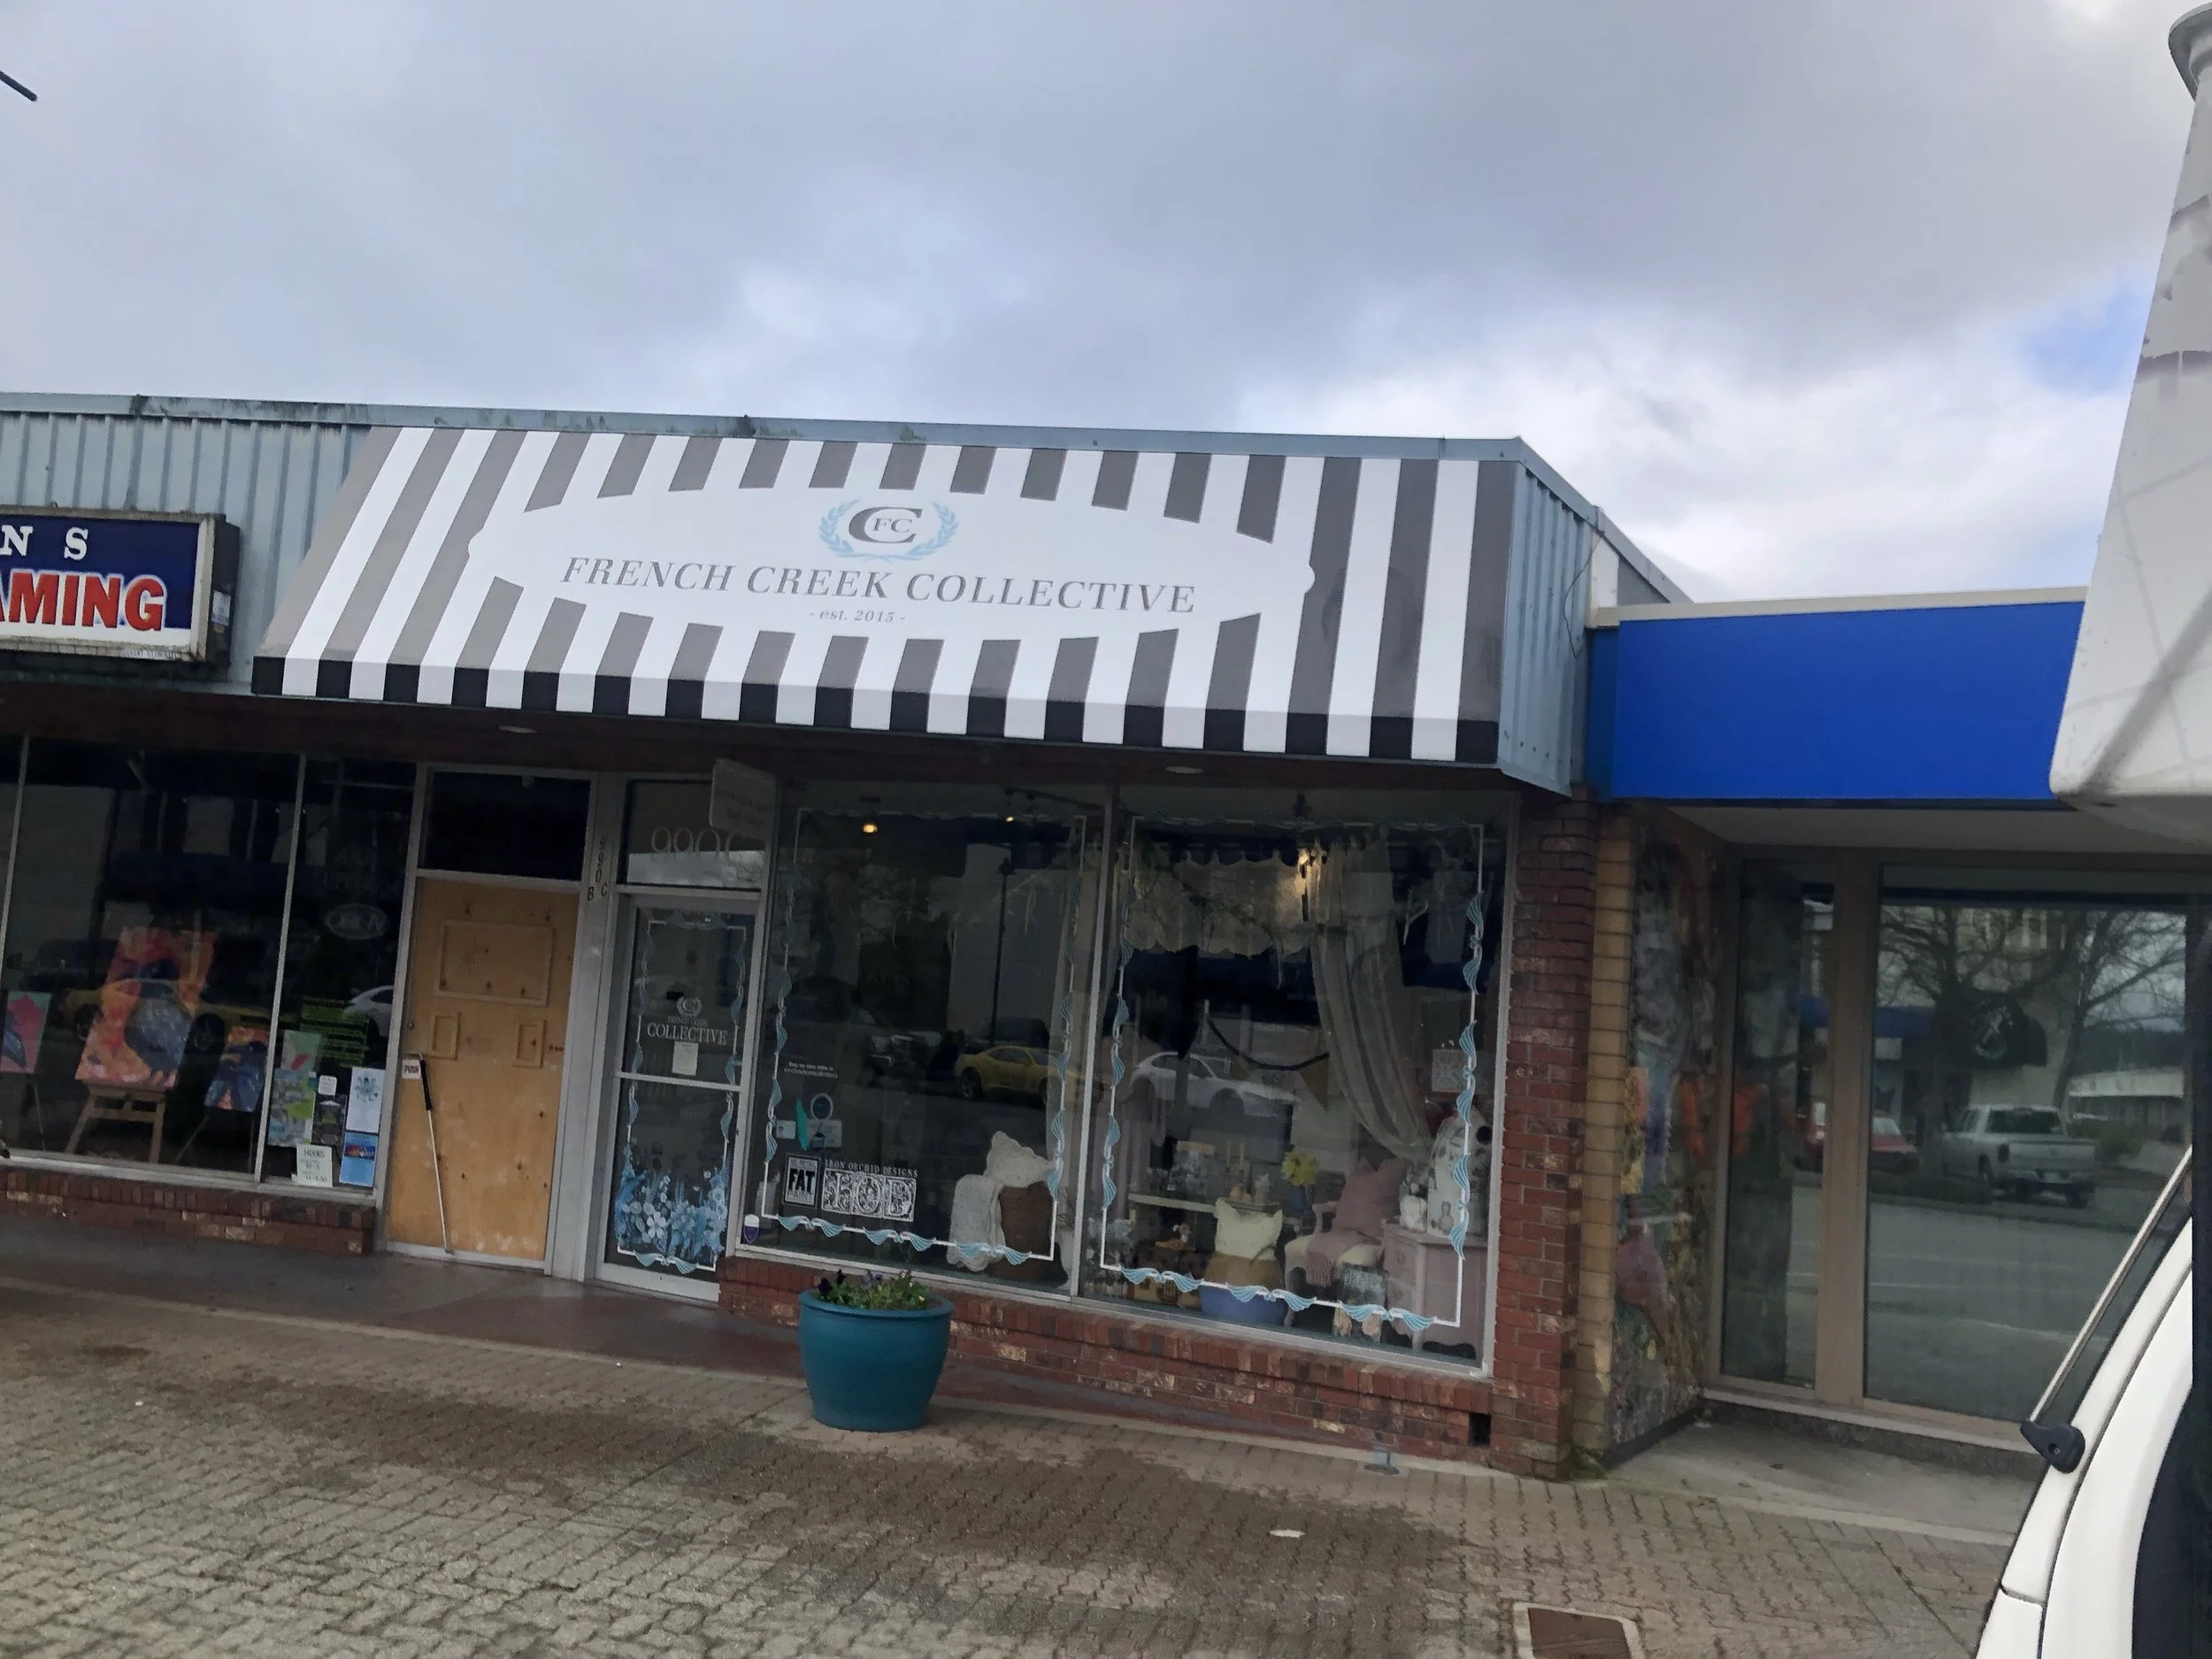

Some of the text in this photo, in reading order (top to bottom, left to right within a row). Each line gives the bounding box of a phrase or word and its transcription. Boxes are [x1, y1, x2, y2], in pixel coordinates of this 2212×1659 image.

[560, 557, 1194, 613] FRENCH CREEK COLLECTIVE
[0, 570, 165, 632] MING
[854, 609, 895, 624] 2015
[647, 1023, 727, 1045] COLLECTIVE
[788, 1168, 816, 1193] FAT
[825, 1159, 846, 1170] IRON
[848, 1162, 880, 1174] ORCHID
[883, 1166, 918, 1179] DESIGNS
